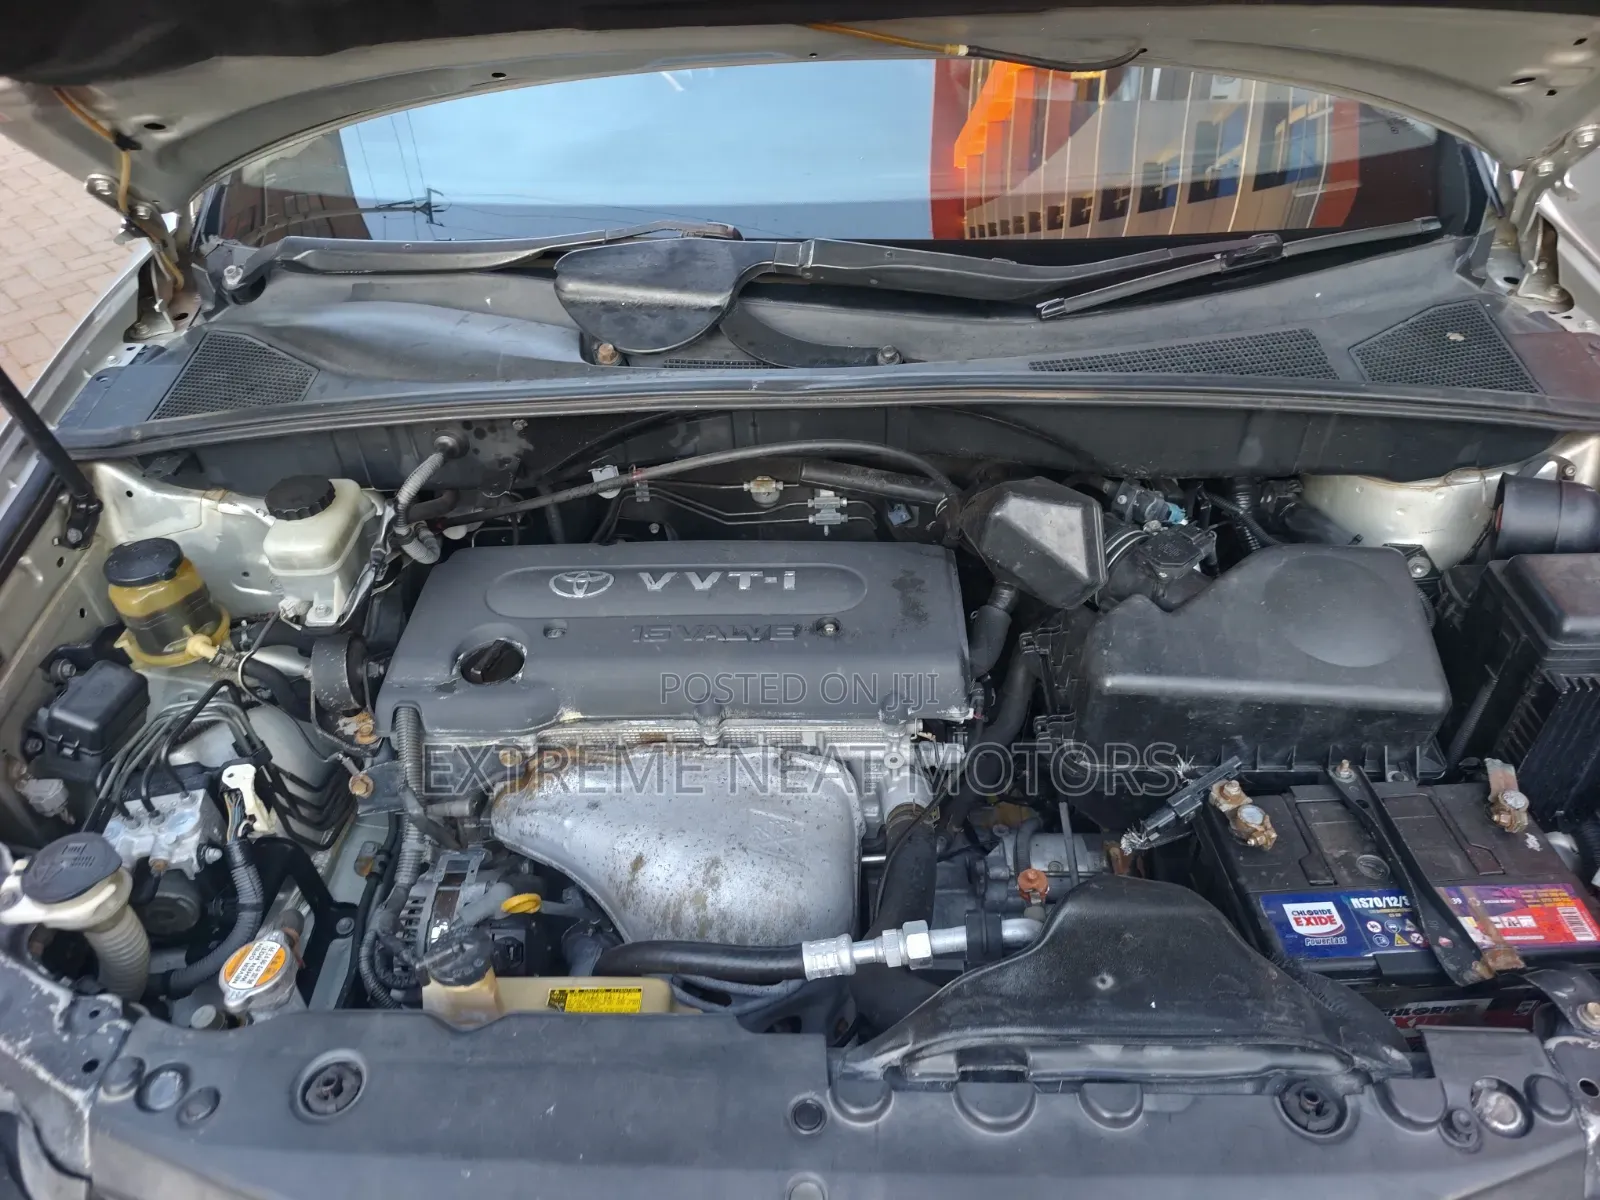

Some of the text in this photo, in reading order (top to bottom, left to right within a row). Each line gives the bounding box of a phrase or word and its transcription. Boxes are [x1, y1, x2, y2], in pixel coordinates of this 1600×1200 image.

[676, 624, 796, 643] VALVE
[1293, 916, 1337, 926] EXIDE
[232, 943, 263, 984] NEVER OPEN
[241, 962, 257, 981] WHEN
